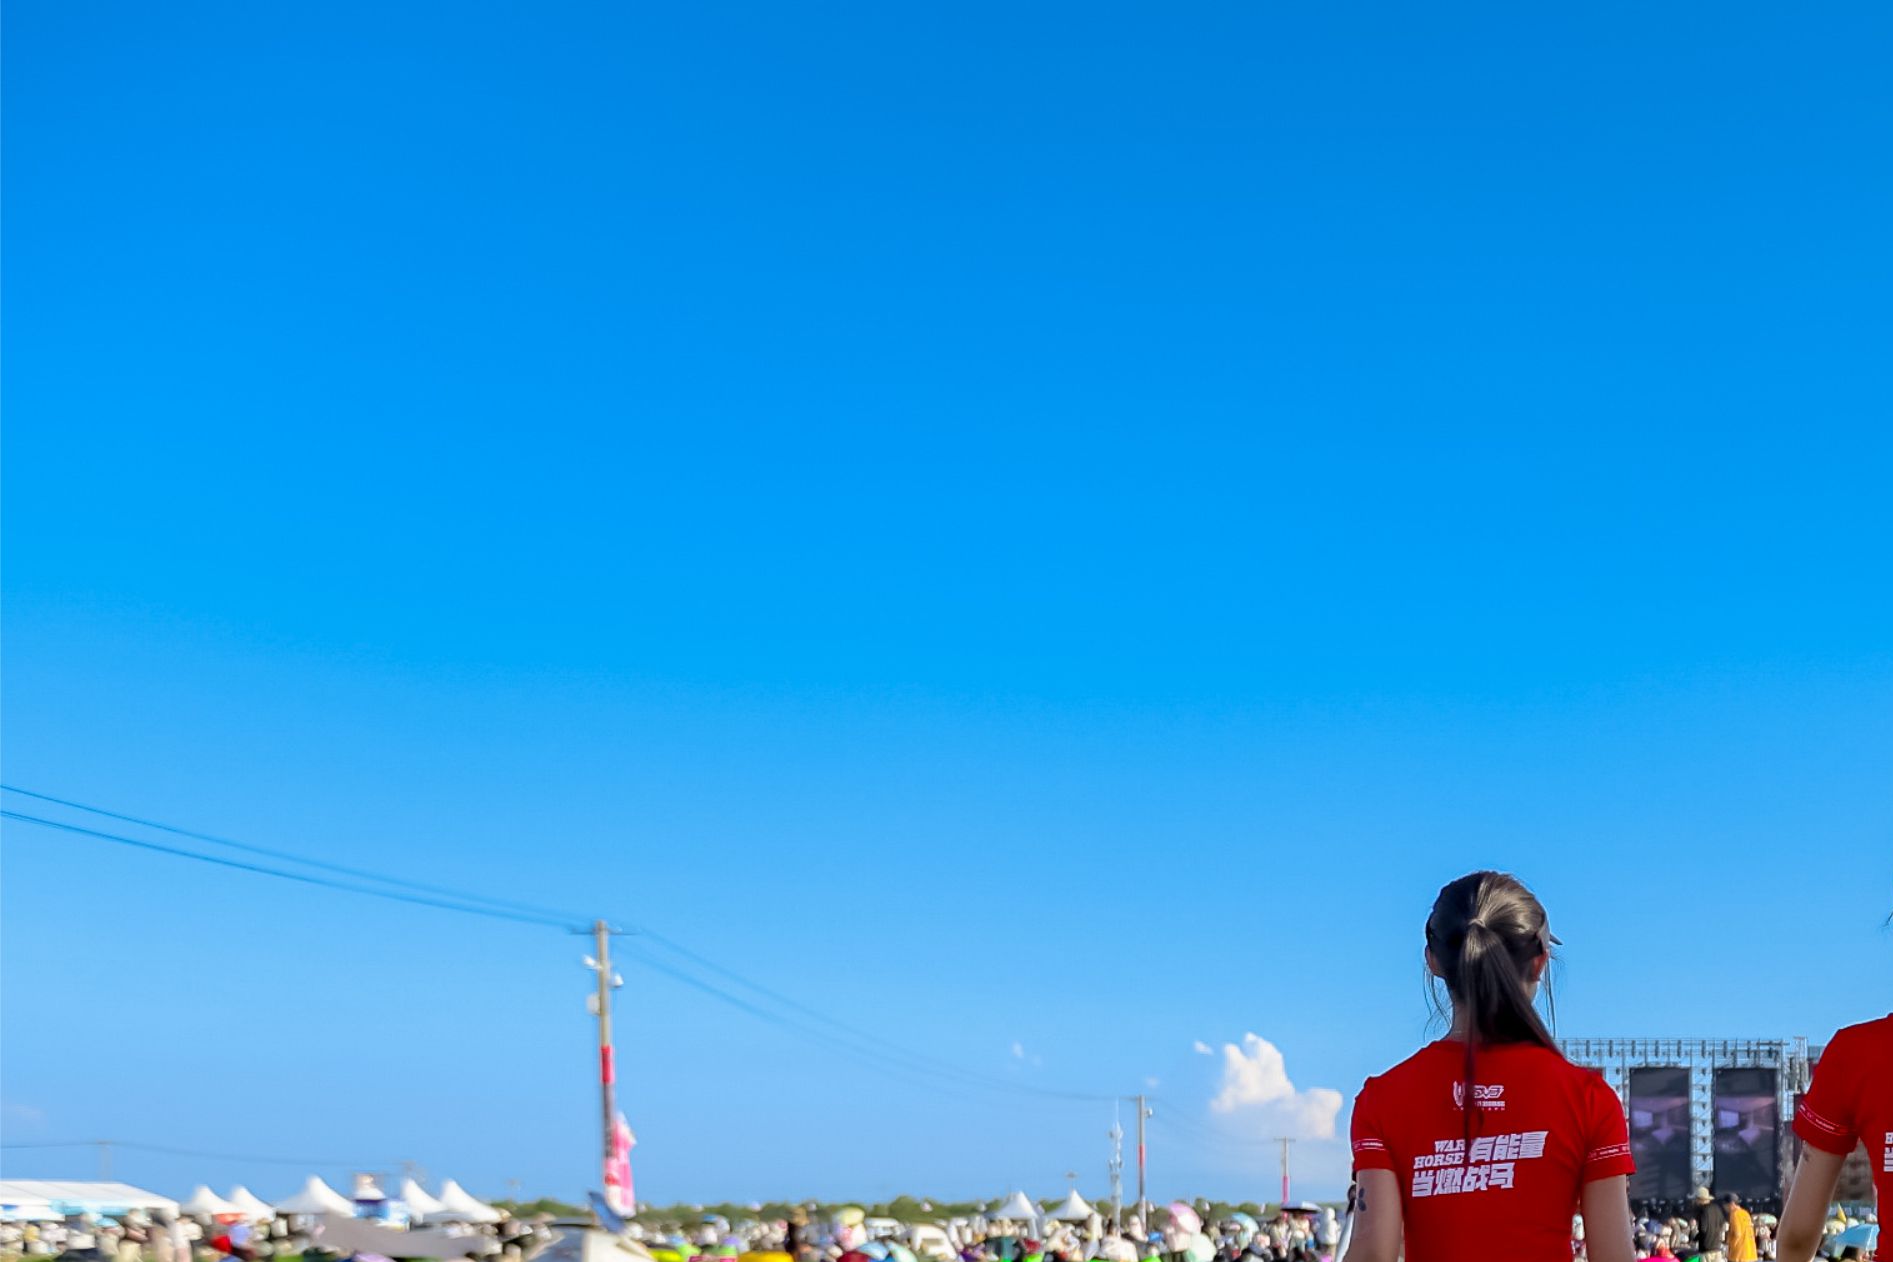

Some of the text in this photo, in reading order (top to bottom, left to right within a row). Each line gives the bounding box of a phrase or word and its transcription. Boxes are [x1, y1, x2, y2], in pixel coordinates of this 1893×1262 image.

[1434, 1139, 1466, 1153] WAR
[1469, 1131, 1548, 1162] 有能量
[1413, 1152, 1465, 1169] HORSE
[1412, 1162, 1515, 1197] 当燃战马
